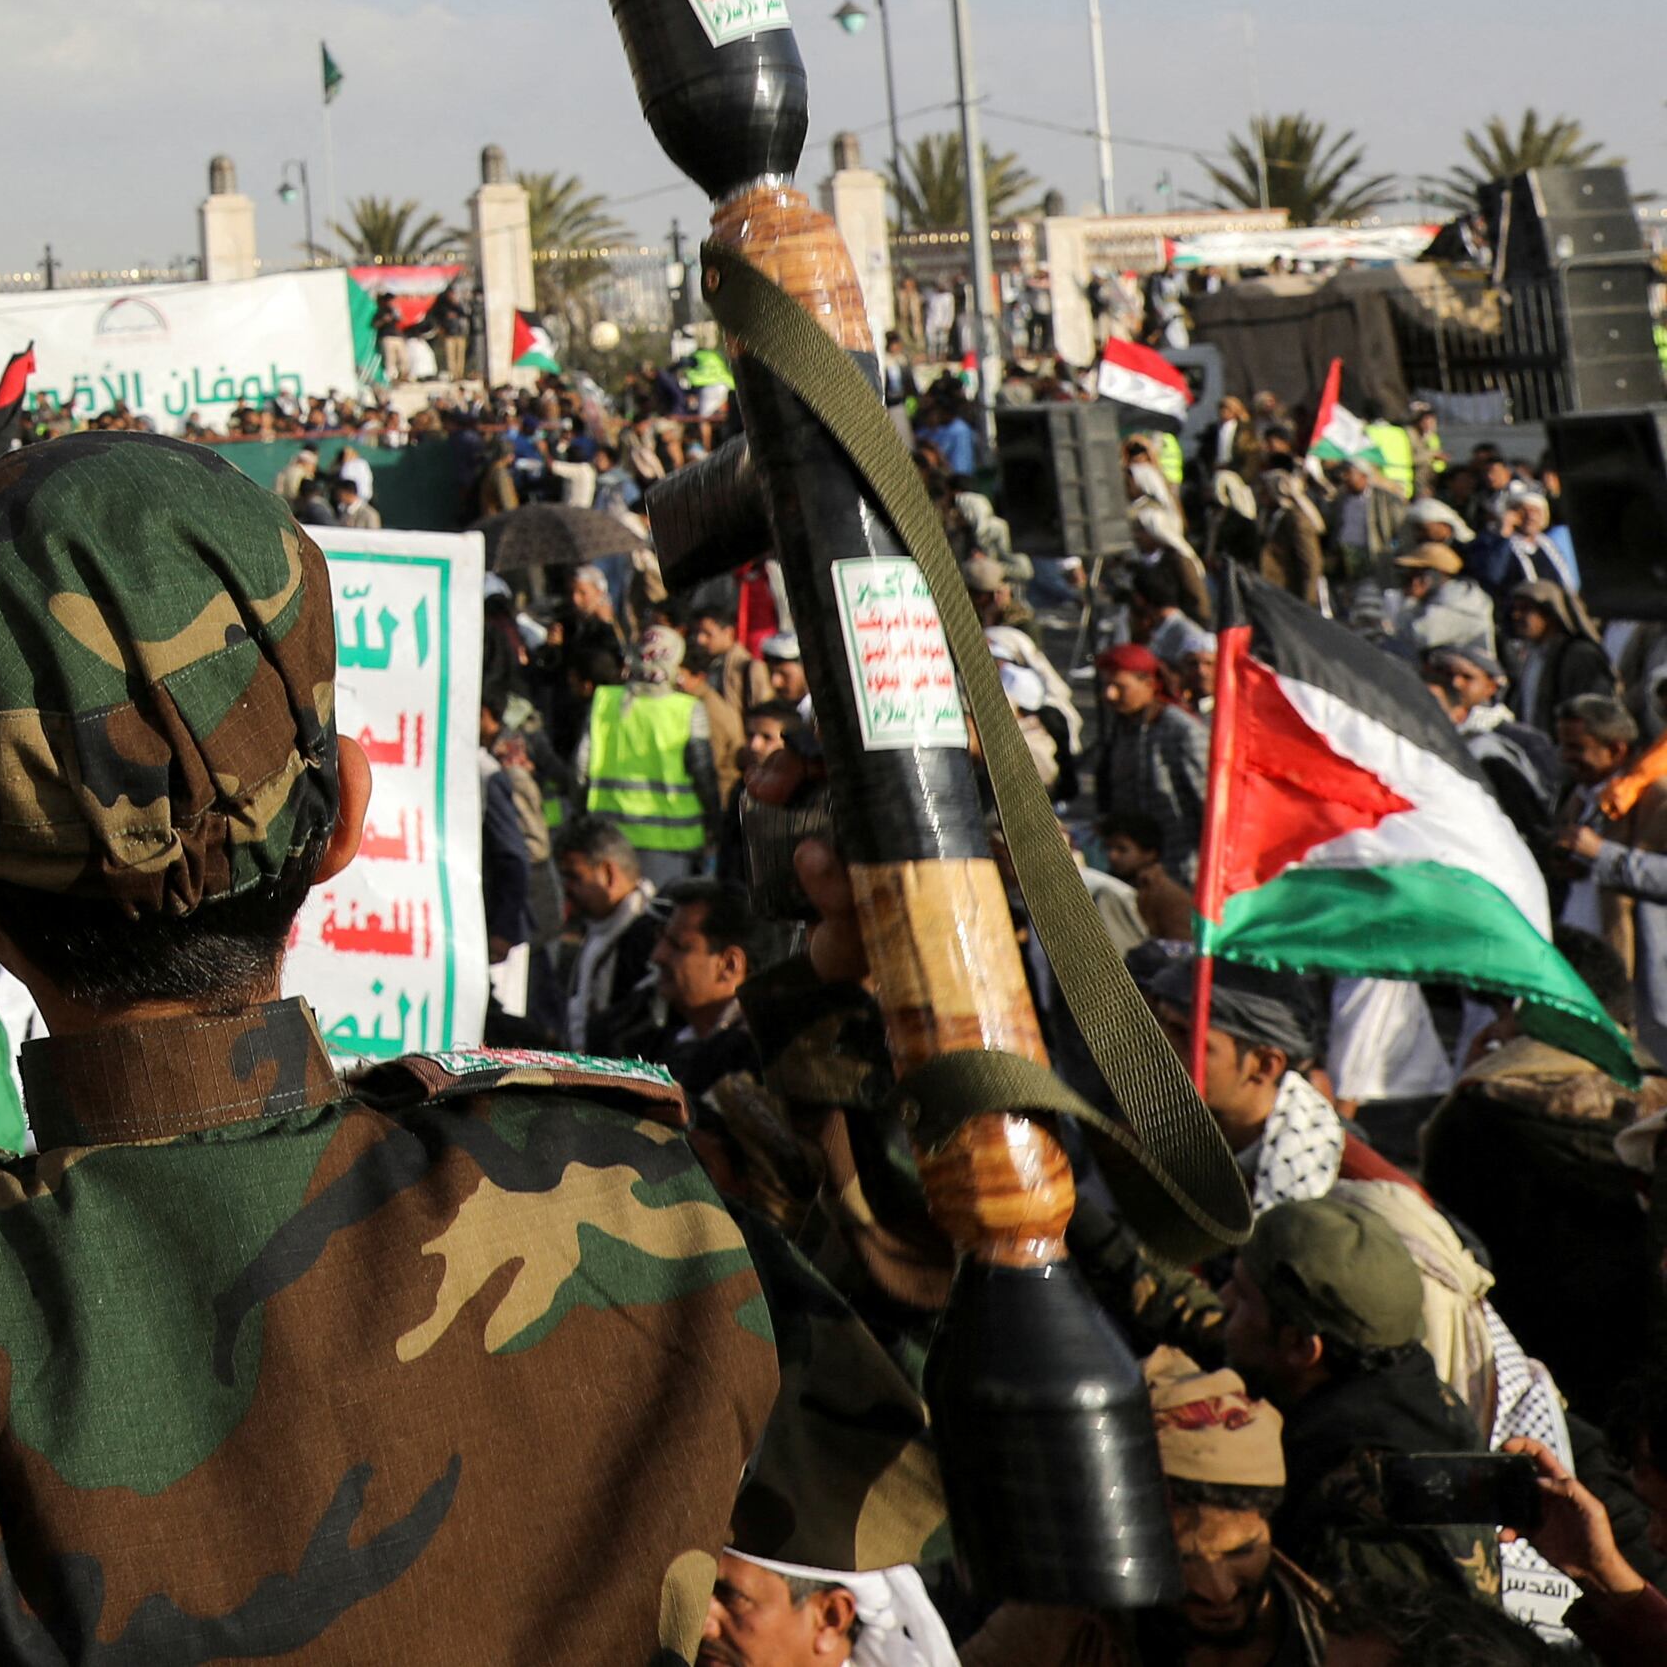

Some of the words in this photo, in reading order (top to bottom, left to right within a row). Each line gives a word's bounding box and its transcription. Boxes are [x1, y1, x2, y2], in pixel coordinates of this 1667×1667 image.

[164, 362, 303, 416] طوفان
[357, 711, 424, 769] الم
[357, 807, 425, 864] الم
[322, 891, 432, 959] اللعنة
[318, 978, 429, 1059] النص
[1506, 1578, 1570, 1599] القدس
